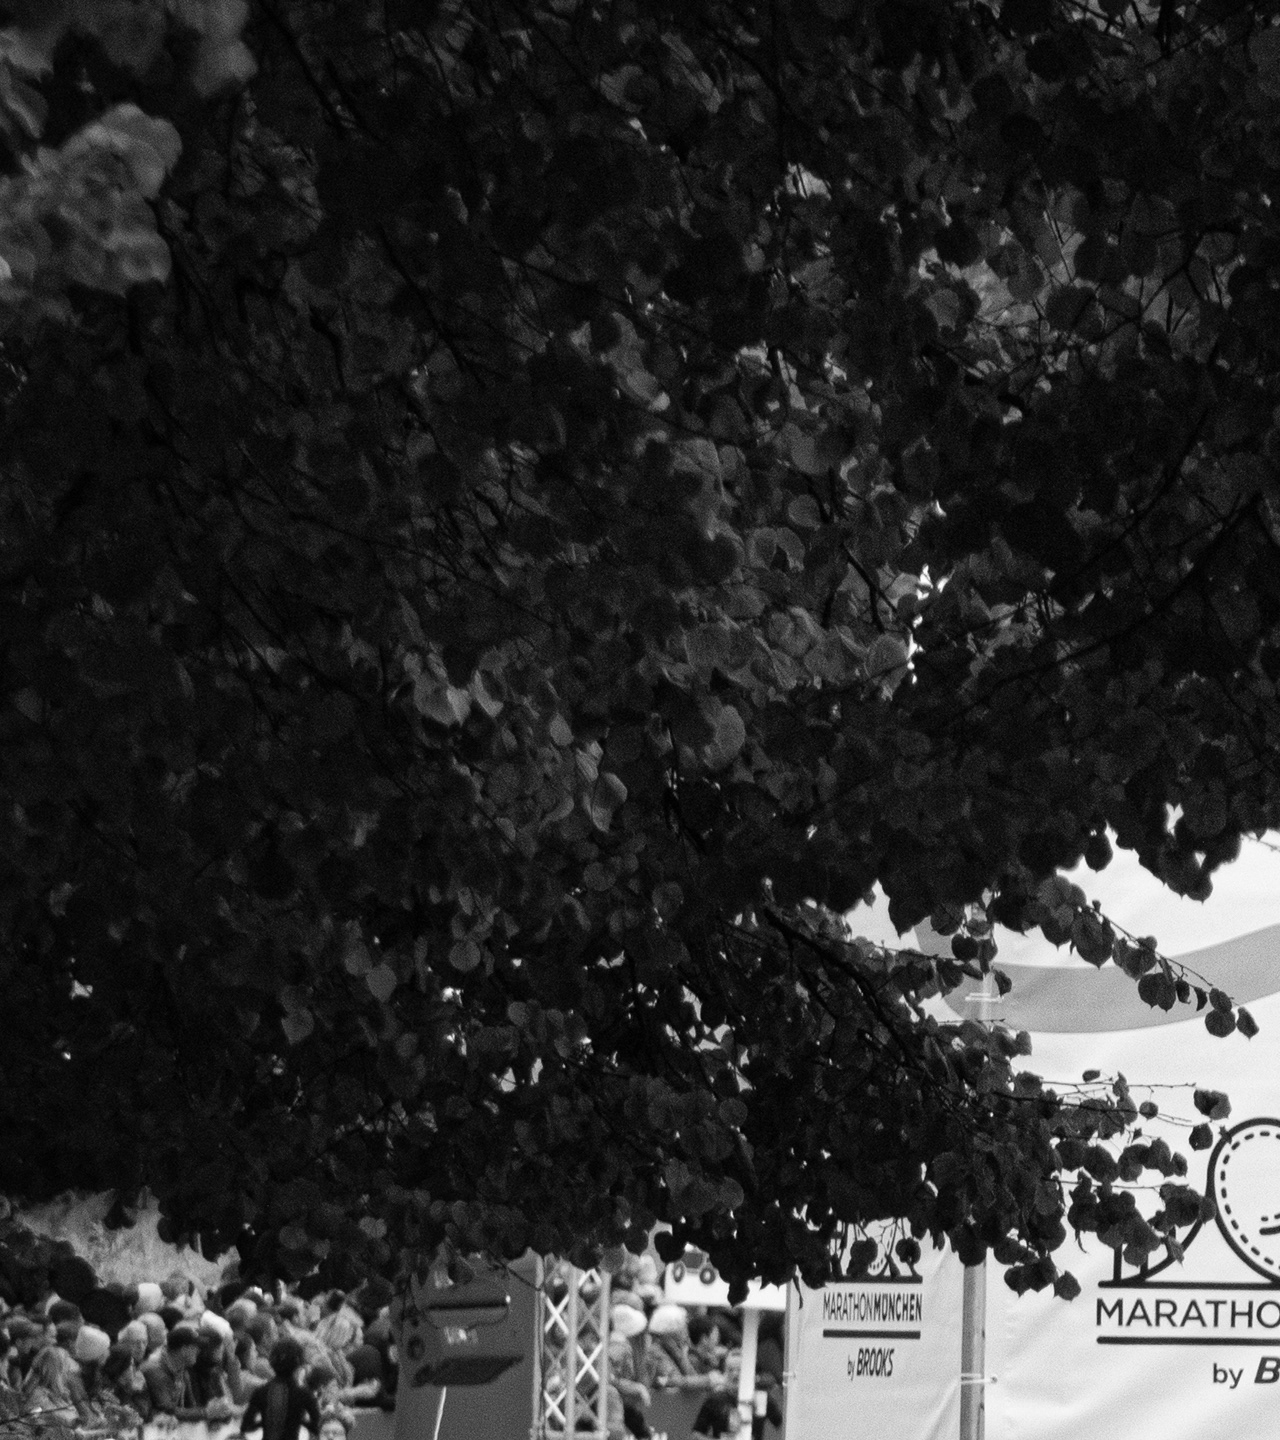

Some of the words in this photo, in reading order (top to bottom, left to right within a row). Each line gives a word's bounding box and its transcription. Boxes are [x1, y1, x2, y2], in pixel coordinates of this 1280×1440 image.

[847, 1354, 855, 1381] by
[856, 1347, 895, 1377] BROOKS
[1212, 1362, 1244, 1389] by
